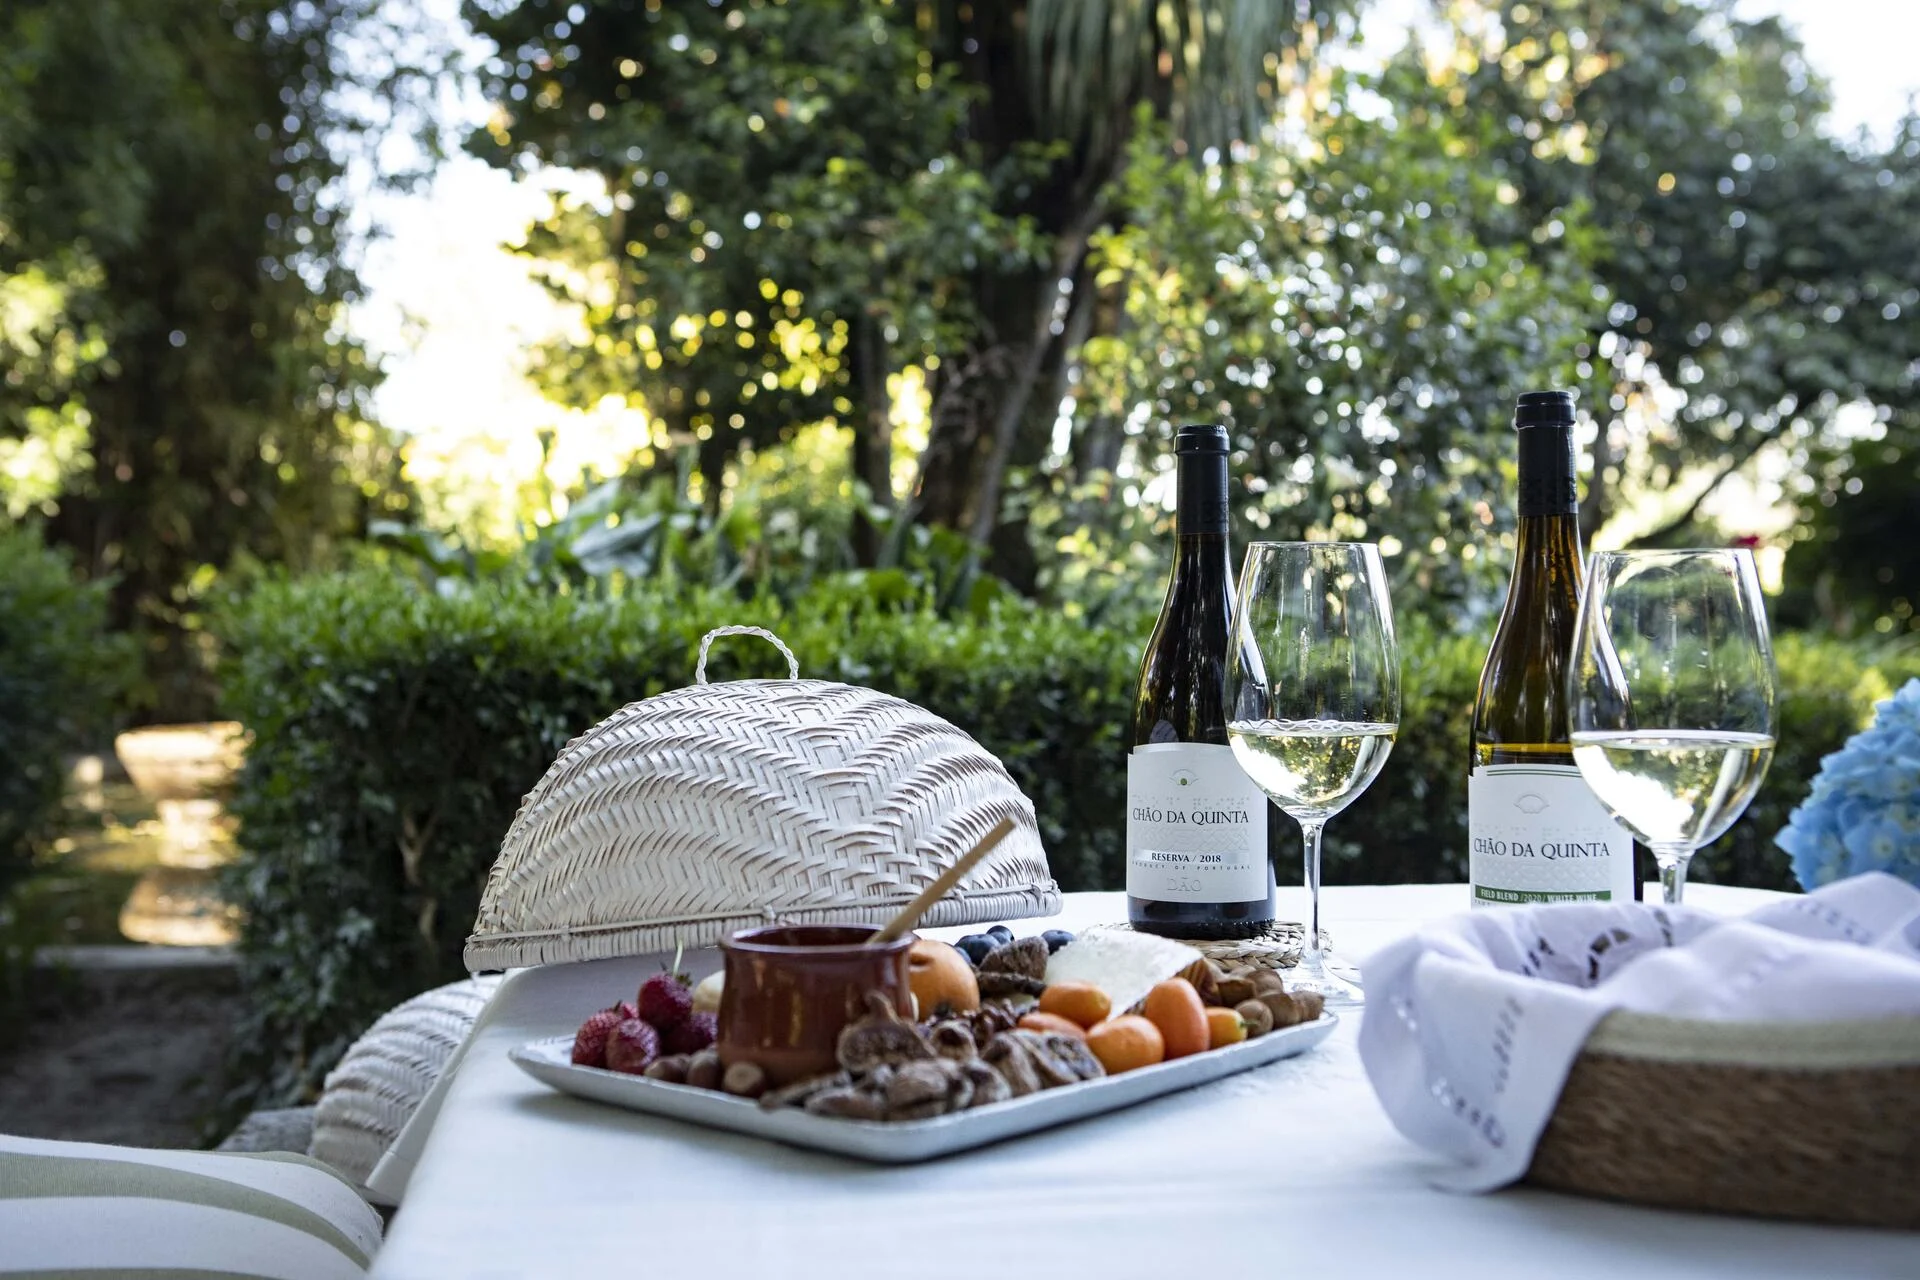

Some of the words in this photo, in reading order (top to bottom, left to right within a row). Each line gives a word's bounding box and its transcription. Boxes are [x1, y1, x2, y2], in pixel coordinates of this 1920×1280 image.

[1133, 807, 1162, 822] CHÃO
[1167, 811, 1186, 823] DA
[1192, 811, 1249, 825] QUINTA
[1474, 838, 1506, 856] CHÃO
[1512, 843, 1535, 858] DA
[1541, 843, 1610, 860] QUINTA
[1151, 852, 1190, 862] RESERVA
[1199, 854, 1222, 863] 2018
[1481, 889, 1496, 899] FIELD
[1496, 891, 1519, 901] BLEND
